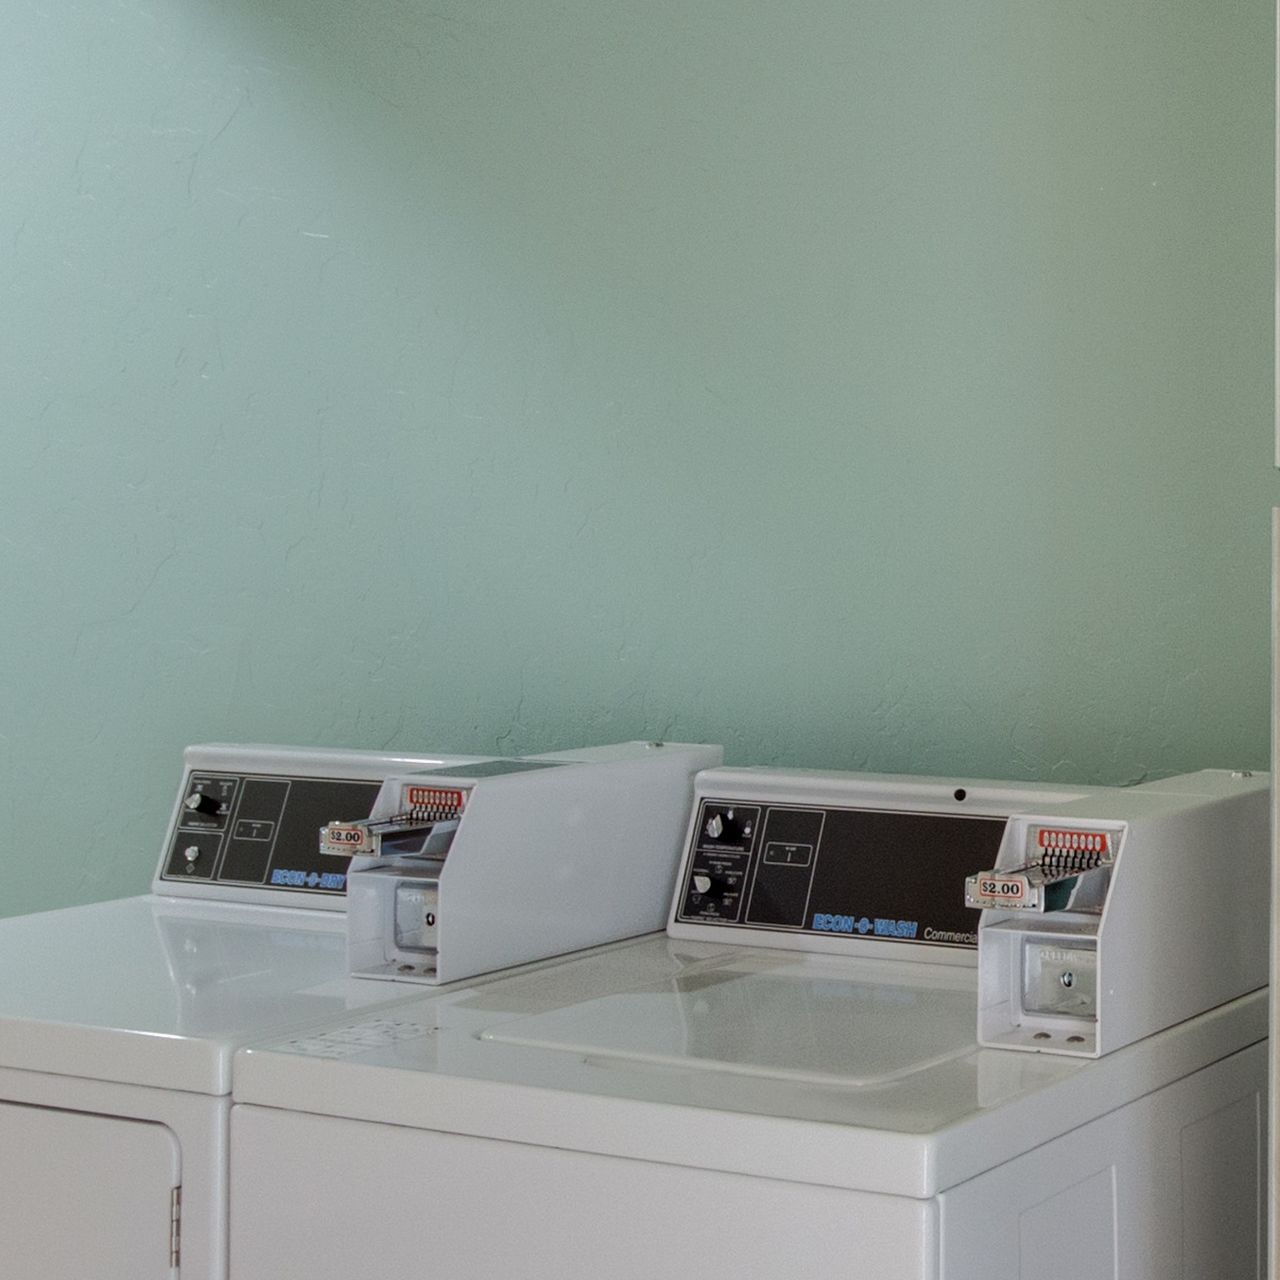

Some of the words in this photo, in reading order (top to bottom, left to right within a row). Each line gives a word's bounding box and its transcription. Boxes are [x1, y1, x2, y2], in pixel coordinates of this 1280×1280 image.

[330, 829, 361, 843] $2.00
[981, 881, 1020, 896] $2.00
[812, 912, 919, 939] ECON-O-WASH
[924, 927, 978, 944] Commercia
